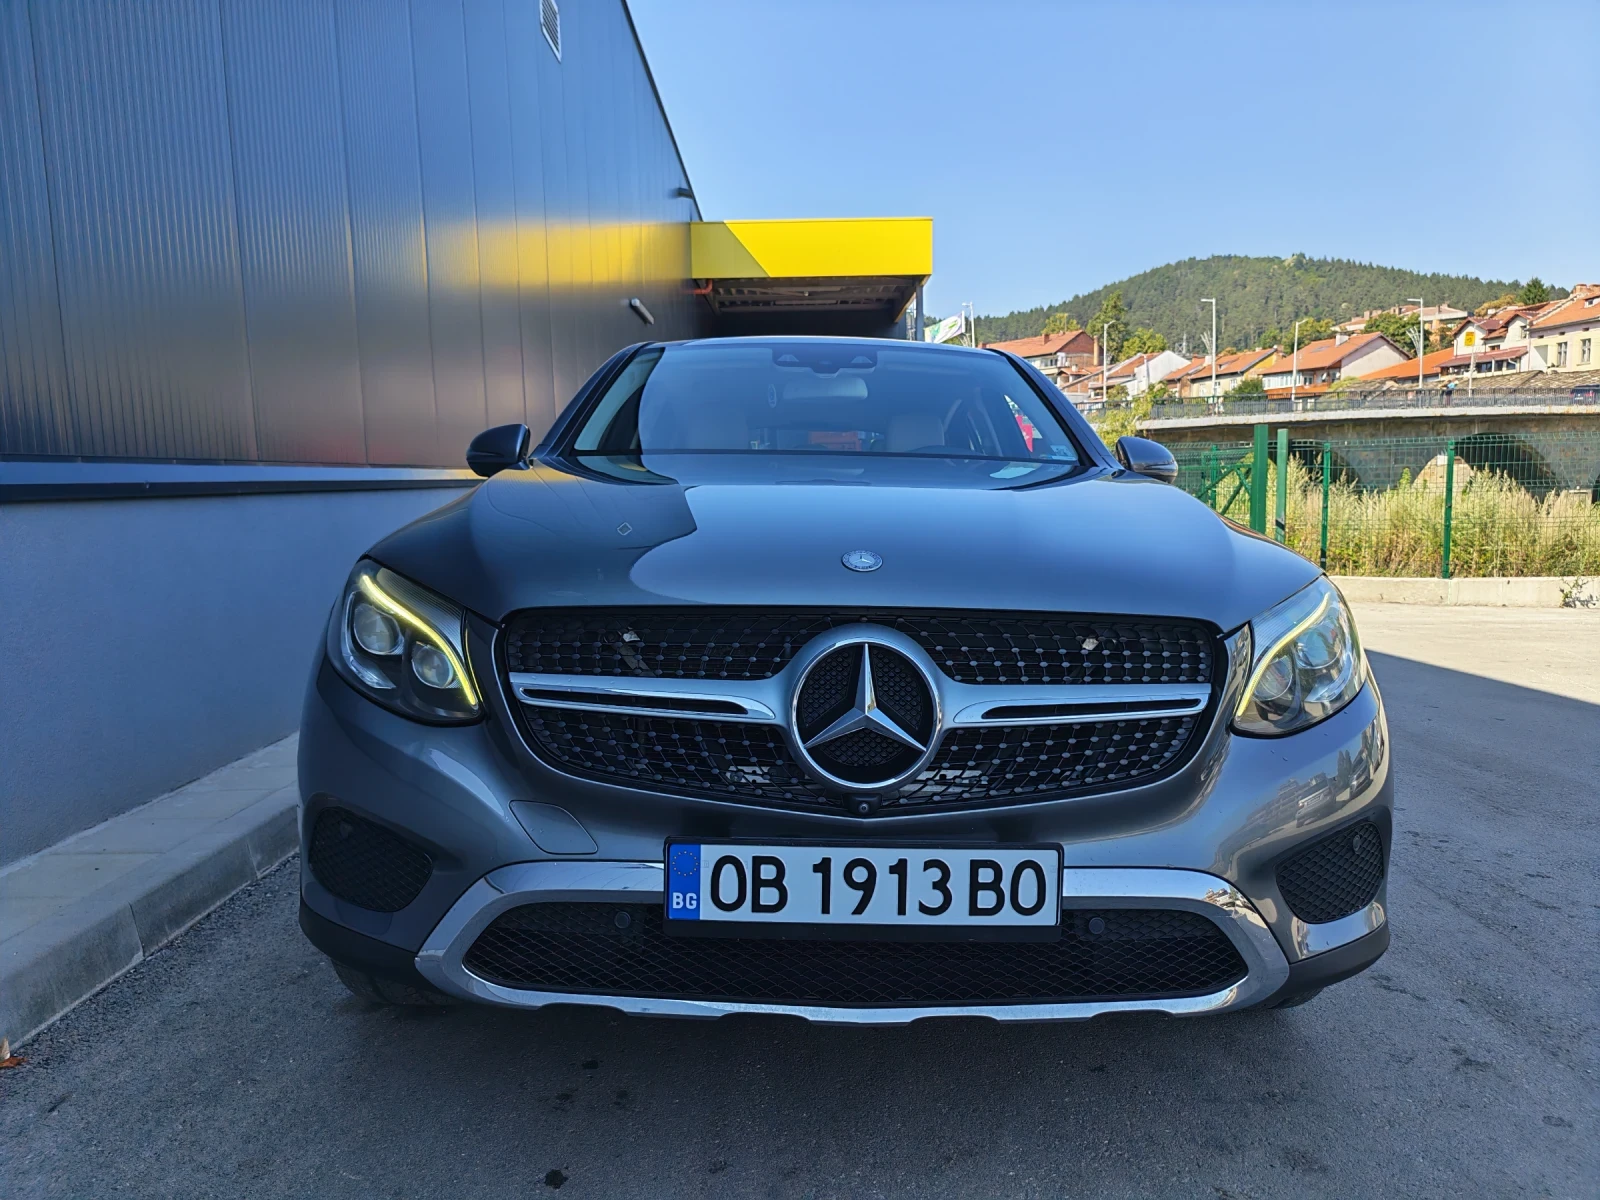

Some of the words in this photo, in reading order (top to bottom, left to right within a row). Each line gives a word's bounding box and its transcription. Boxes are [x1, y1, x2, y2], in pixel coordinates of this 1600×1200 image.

[672, 892, 697, 909] BG
[710, 855, 788, 913] OB
[812, 857, 953, 916] 1913
[968, 859, 1047, 917] BO
